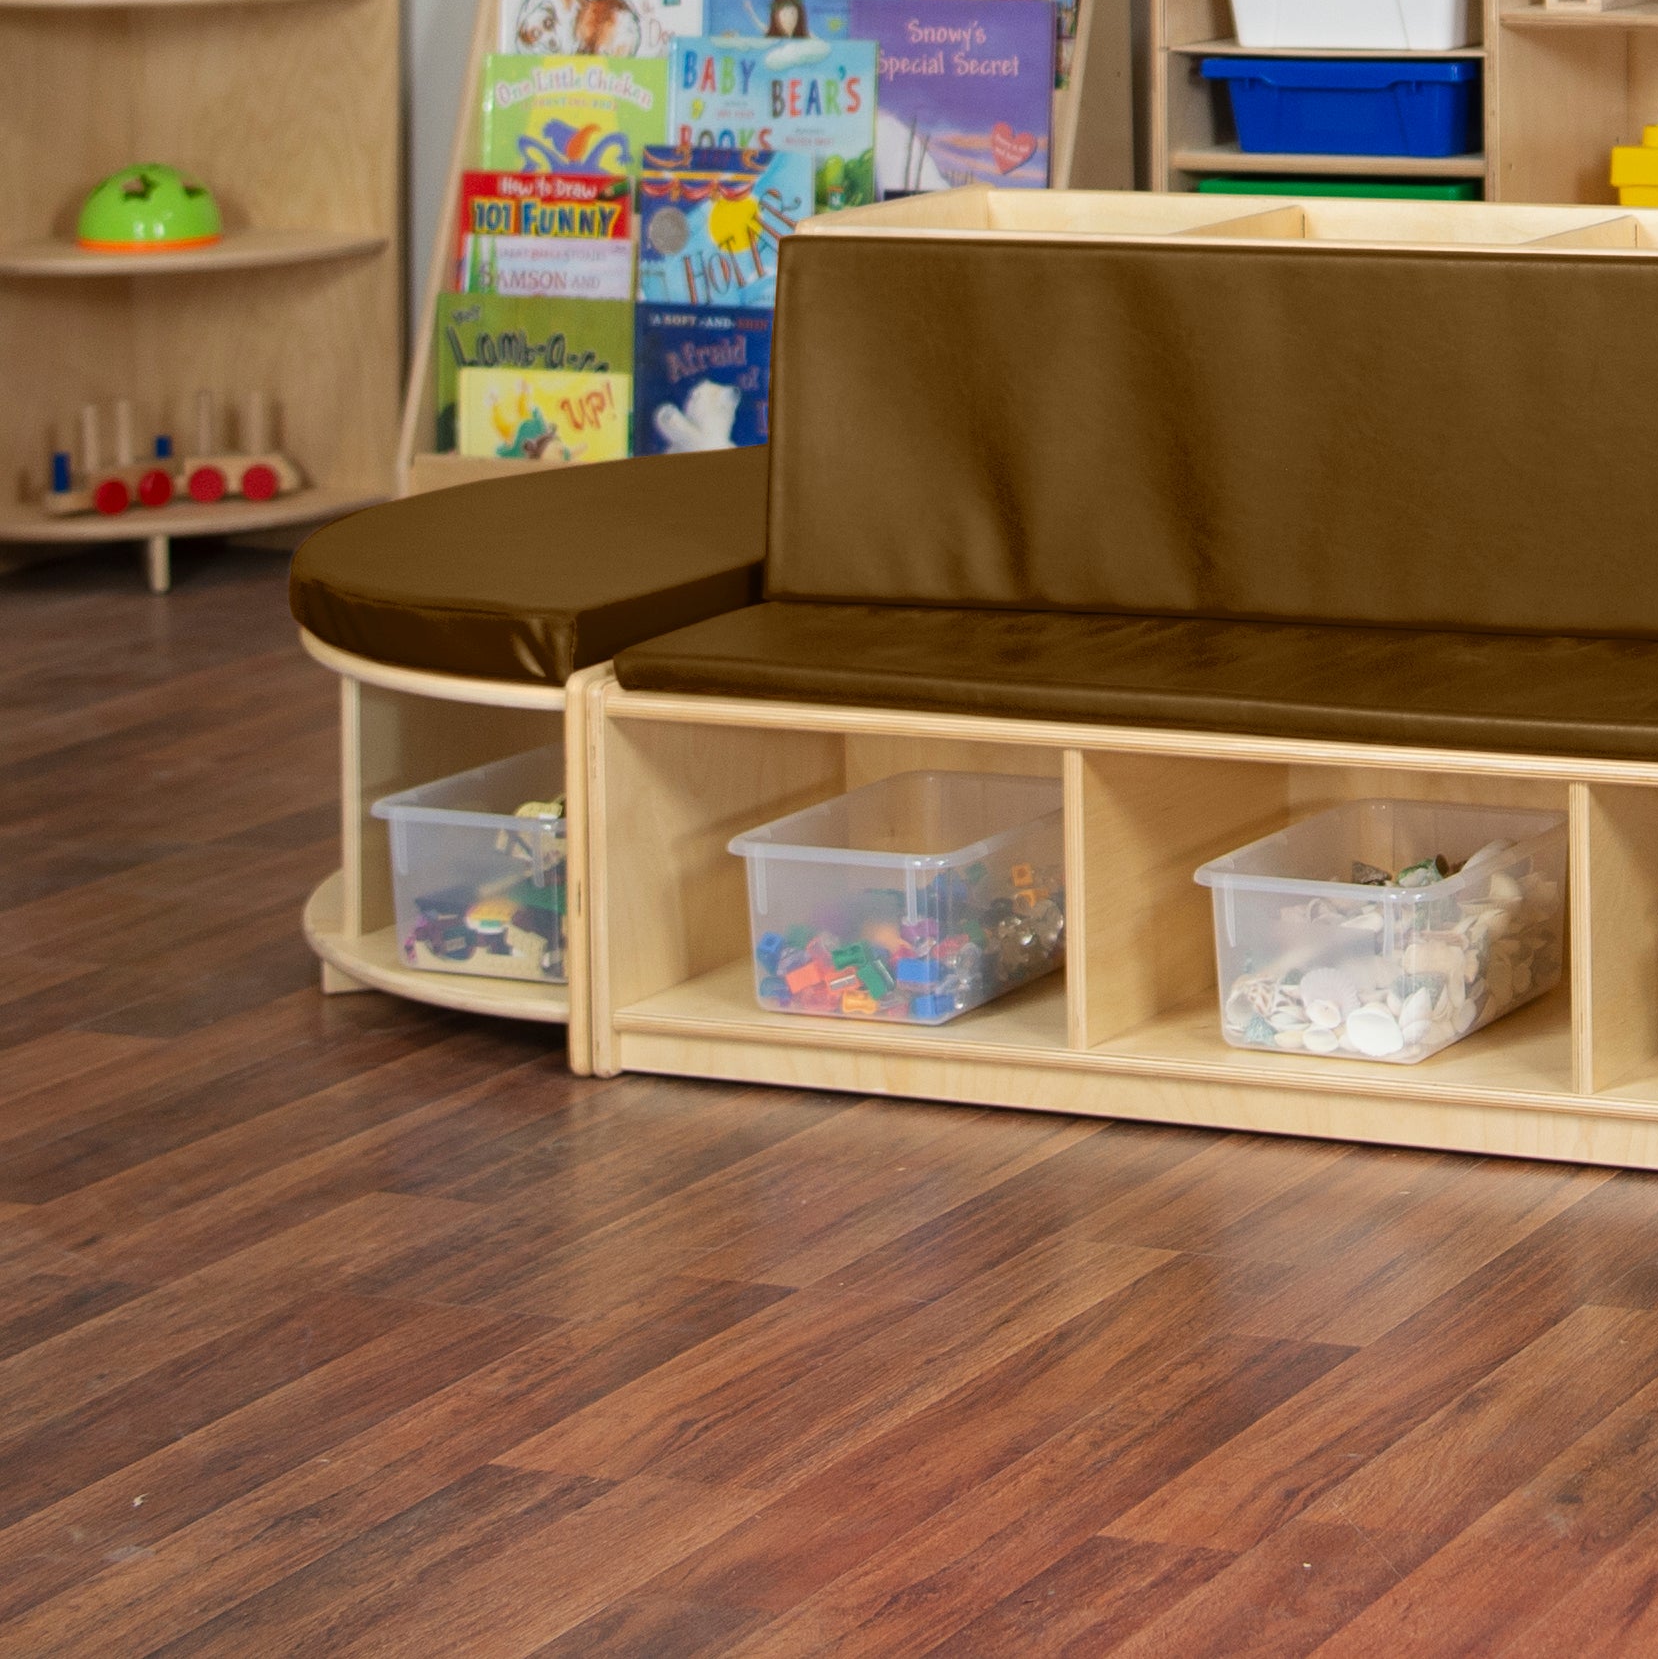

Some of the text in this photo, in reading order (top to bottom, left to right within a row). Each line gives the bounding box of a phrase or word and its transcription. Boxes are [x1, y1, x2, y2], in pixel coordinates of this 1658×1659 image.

[908, 17, 987, 52] Snowy's
[683, 50, 862, 119] BABY BEAR'S
[878, 49, 1020, 82] Special Secret
[497, 66, 654, 110] One Little Chicken
[501, 176, 598, 199] How to Draw
[474, 200, 618, 237] 101 FUNNY
[479, 262, 602, 291] SAMSON AND
[683, 235, 746, 306] HOT
[665, 334, 747, 383] Afraid
[560, 380, 618, 432] UP!
